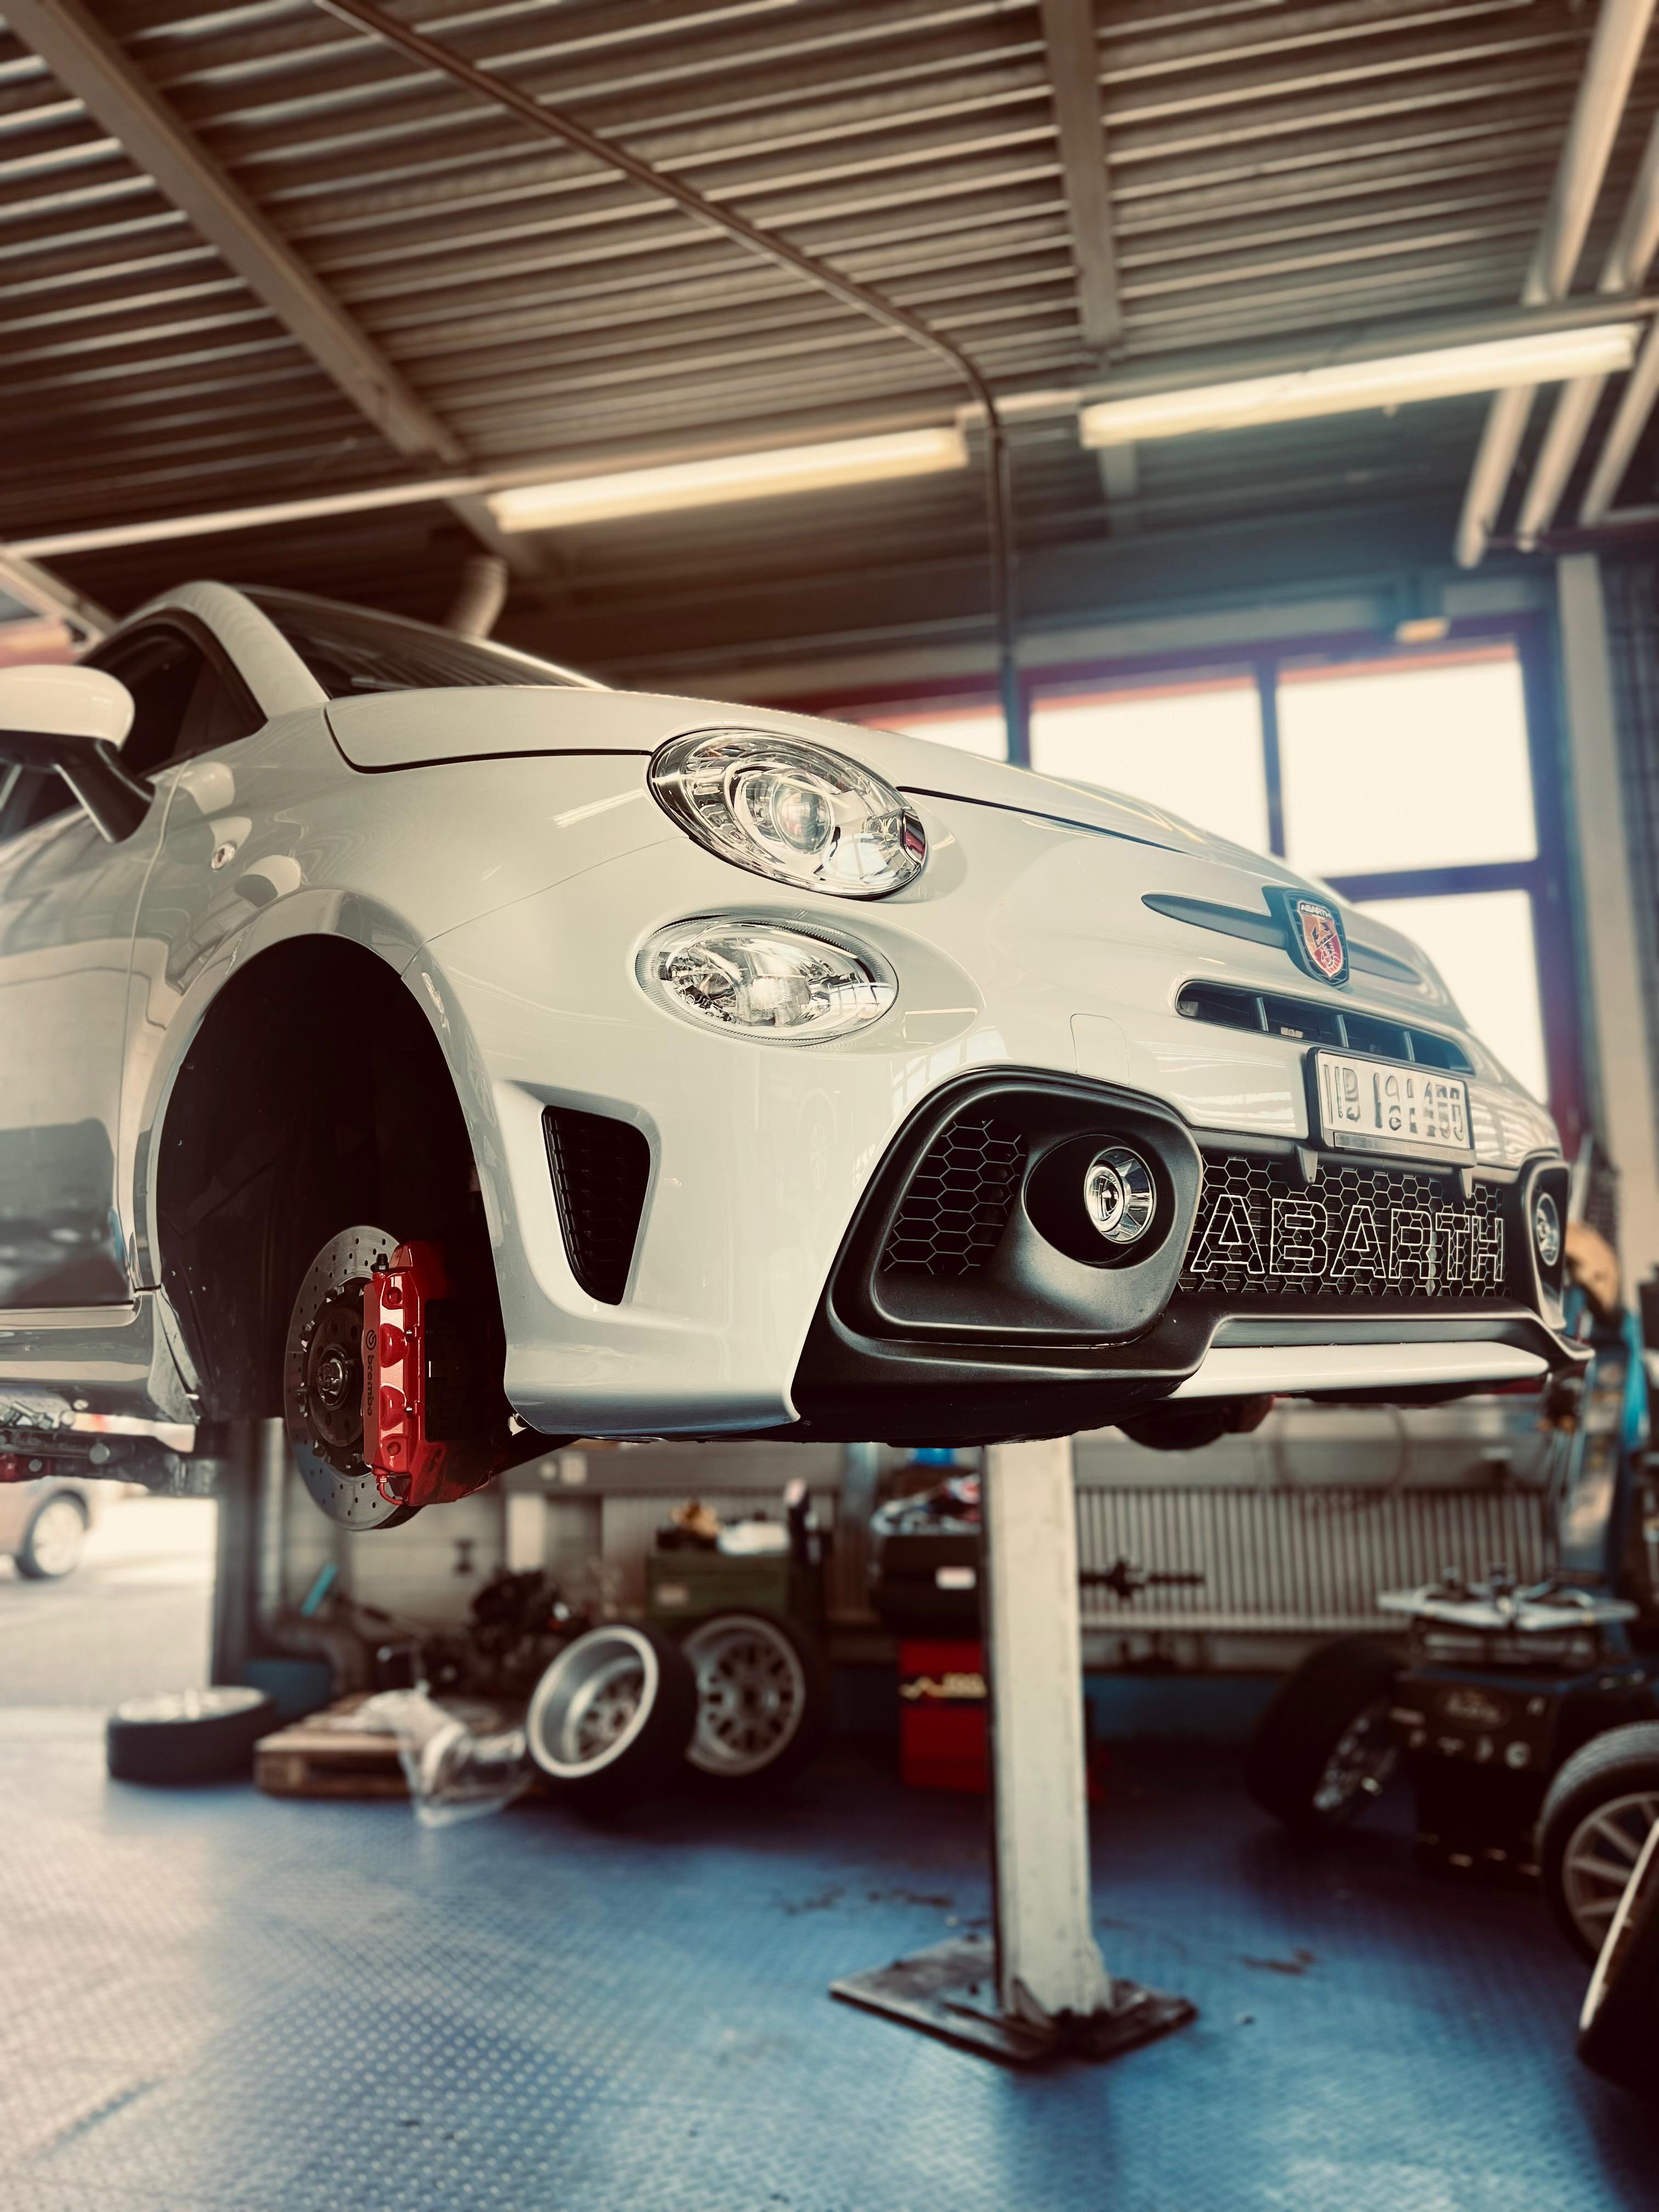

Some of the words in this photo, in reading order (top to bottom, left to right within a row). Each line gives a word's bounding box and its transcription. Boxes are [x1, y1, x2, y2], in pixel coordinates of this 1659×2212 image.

[1300, 904, 1331, 919] ABARTH
[1190, 1194, 1504, 1282] ABARTH
[366, 1355, 375, 1417] brembo
